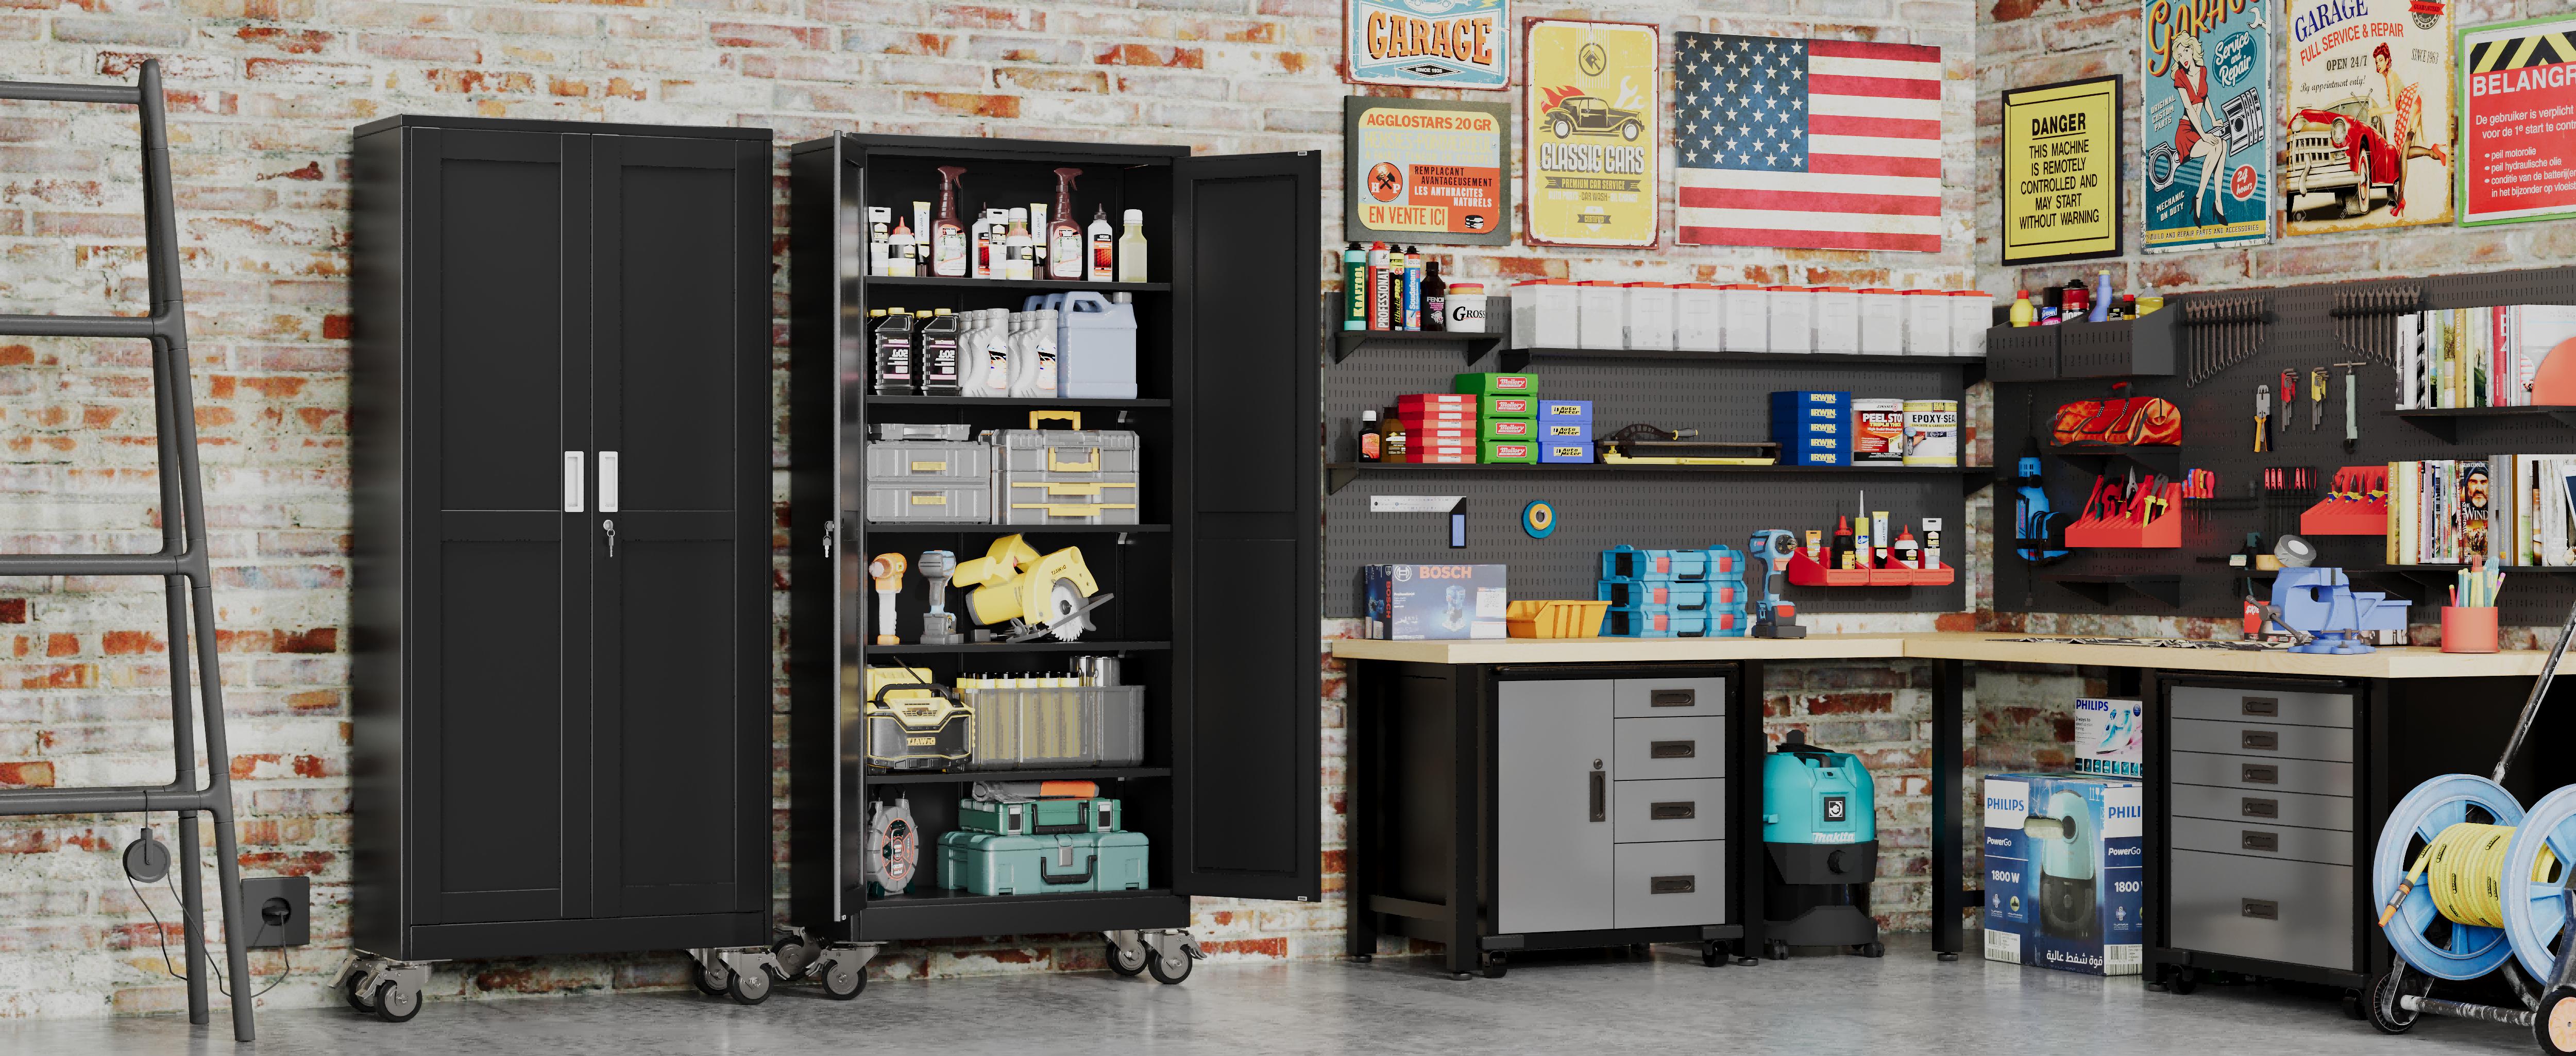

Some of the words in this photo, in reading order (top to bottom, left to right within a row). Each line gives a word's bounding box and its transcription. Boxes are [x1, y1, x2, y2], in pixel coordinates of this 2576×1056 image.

[2295, 0, 2368, 42] GARAGE
[1368, 10, 1493, 65] GARAGE
[2300, 42, 2321, 66] FULL
[2322, 25, 2360, 52] SERVICE
[2363, 24, 2368, 38] &
[2371, 22, 2403, 37] REPAIR
[2215, 31, 2249, 65] Service
[2412, 48, 2427, 62] SINCE
[2427, 49, 2438, 64] 1963
[2231, 49, 2241, 64] and
[2327, 58, 2347, 71] OPEN
[2351, 55, 2367, 68] 24/7
[2219, 55, 2251, 88] Repair
[2301, 83, 2309, 94] By
[2312, 79, 2348, 93] appointment
[2350, 75, 2366, 87] only!
[2151, 94, 2176, 115] ORIGINAL
[1367, 113, 1453, 129] AGGLOSTARS
[1455, 117, 1471, 130] 20
[1473, 118, 1492, 131] GR
[2152, 106, 2174, 124] CUSTOM
[2476, 115, 2487, 125] De
[2489, 111, 2528, 126] gebruiker
[2530, 109, 2536, 119] is
[2539, 105, 2573, 119] verplicht
[2032, 112, 2087, 136] DANGER
[2155, 116, 2172, 131] PARTS
[2482, 129, 2500, 139] voor
[2502, 127, 2512, 137] de
[2526, 124, 2544, 134] start
[2546, 123, 2554, 132] te
[2029, 144, 2047, 159] THIS
[2052, 139, 2089, 157] MACHINE
[2492, 150, 2503, 161] peil
[2505, 147, 2536, 158] motorolie
[1541, 142, 1603, 173] CLASSIC
[1604, 144, 1645, 174] CARS
[2492, 163, 2503, 174] peil
[2505, 159, 2548, 172] hydraulische
[2549, 157, 2562, 165] olie
[2031, 162, 2038, 176] IS
[2043, 158, 2086, 175] REMOTELY
[1421, 176, 1492, 186] AVANTAGEUSEMENT
[2238, 168, 2248, 183] 24
[2492, 174, 2517, 185] conditie
[2519, 174, 2531, 182] van
[2533, 172, 2542, 180] de
[1371, 182, 1379, 193] H
[1393, 183, 1400, 194] P
[1415, 186, 1428, 195] LES
[1431, 186, 1483, 197] ANTHRACITES
[1562, 179, 1588, 189] PREMIUM
[1589, 180, 1601, 190] CAR
[1602, 180, 1624, 190] SERVICE
[2021, 176, 2076, 195] CONTROLLED
[2080, 174, 2097, 189] AND
[2236, 182, 2253, 196] hours
[2492, 189, 2498, 197] in
[2499, 188, 2510, 196] het
[2512, 185, 2542, 198] bijzonder
[2544, 185, 2552, 193] op
[1454, 197, 1492, 207] NATURELS
[1582, 192, 1591, 201] CAR
[1592, 192, 1607, 201] WASH
[2036, 196, 2053, 211] MAY
[2056, 193, 2081, 209] START
[2156, 191, 2185, 213] MECHANIC
[1369, 206, 1386, 224] EN
[1389, 207, 1426, 225] VENTE
[1430, 208, 1445, 226] ICI
[2020, 213, 2056, 230] WITHOUT
[2061, 209, 2099, 225] WARNING
[2160, 212, 2169, 222] ON
[2170, 202, 2184, 218] DUTY
[2150, 232, 2164, 240] BUILD
[2177, 230, 2194, 238] REPAIR
[2197, 228, 2212, 237] PARTS
[2226, 225, 2259, 234] ACCESSORIES
[1353, 266, 1364, 316] KRAFTOOL
[1378, 269, 1388, 328] PROFESSIONAL
[1863, 413, 1887, 422] PEEL
[1419, 567, 1472, 579] BOSCH
[2076, 700, 2109, 711] PHILIPS
[1987, 797, 2024, 811] PHILIPS
[1987, 837, 2011, 846] PowerGo
[2108, 846, 2141, 856] PowerGo
[1991, 870, 2010, 882] 1800
[2011, 872, 2020, 883] W
[2114, 881, 2139, 892] 1800
[2046, 950, 2064, 963] عالية
[2065, 952, 2087, 964] شفط
[2089, 956, 2103, 968] قوة
